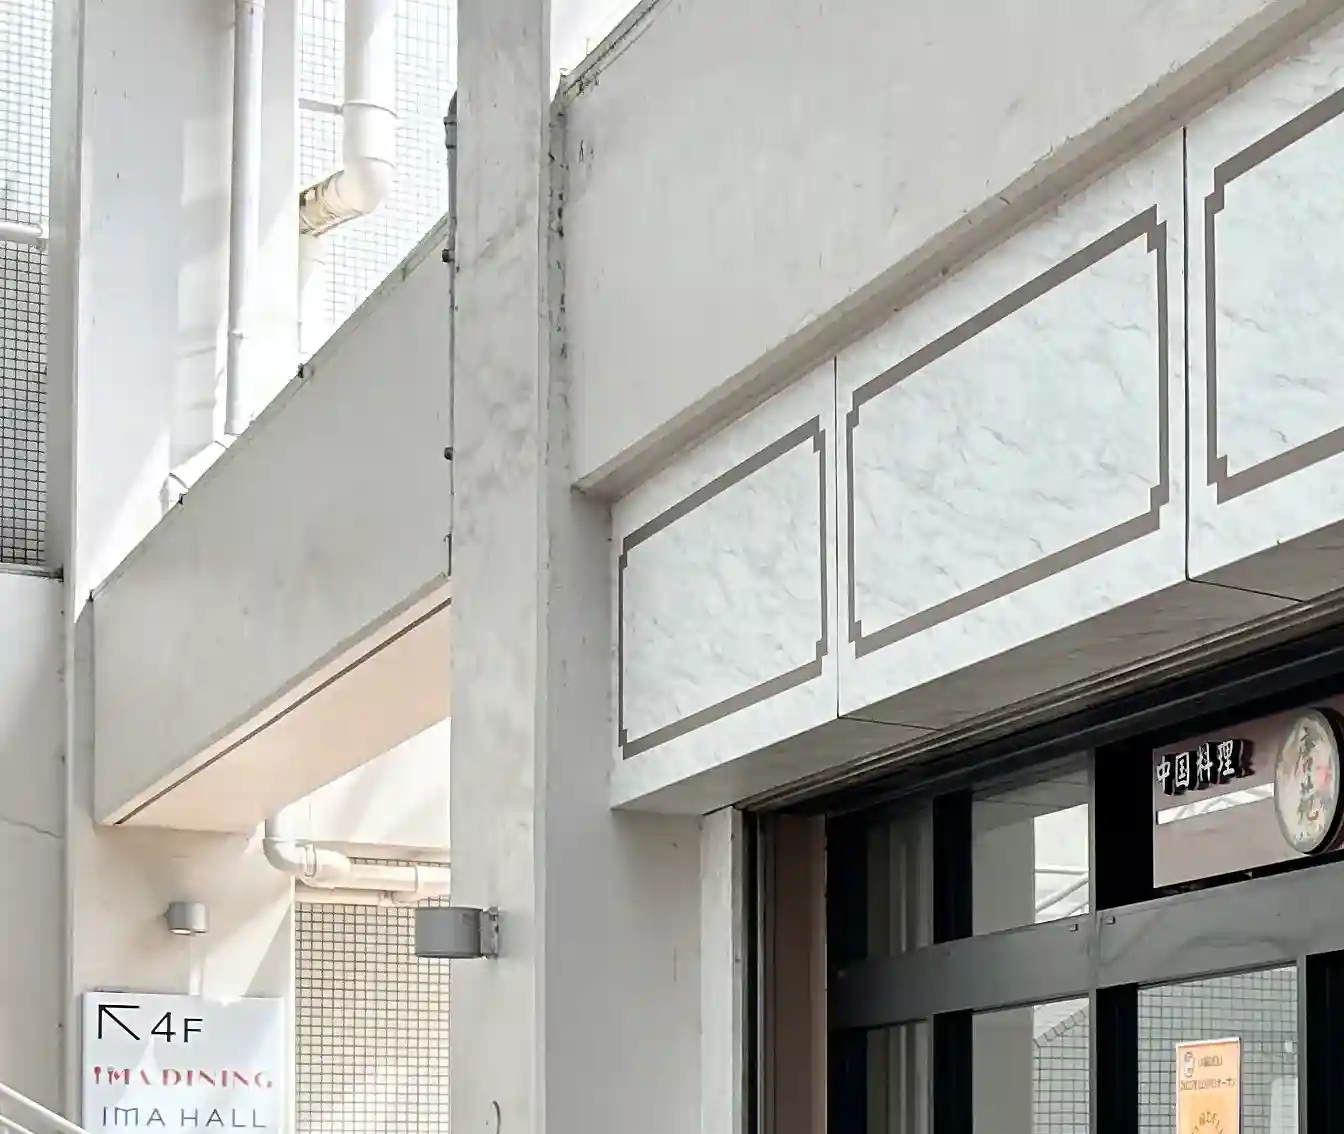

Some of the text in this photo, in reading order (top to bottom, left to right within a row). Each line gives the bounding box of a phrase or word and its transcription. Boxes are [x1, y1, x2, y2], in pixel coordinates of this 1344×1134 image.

[1156, 738, 1236, 790] 中国料理
[150, 1011, 204, 1043] 4F
[161, 1068, 274, 1089] DINING
[102, 1106, 268, 1129] IMA HALL
